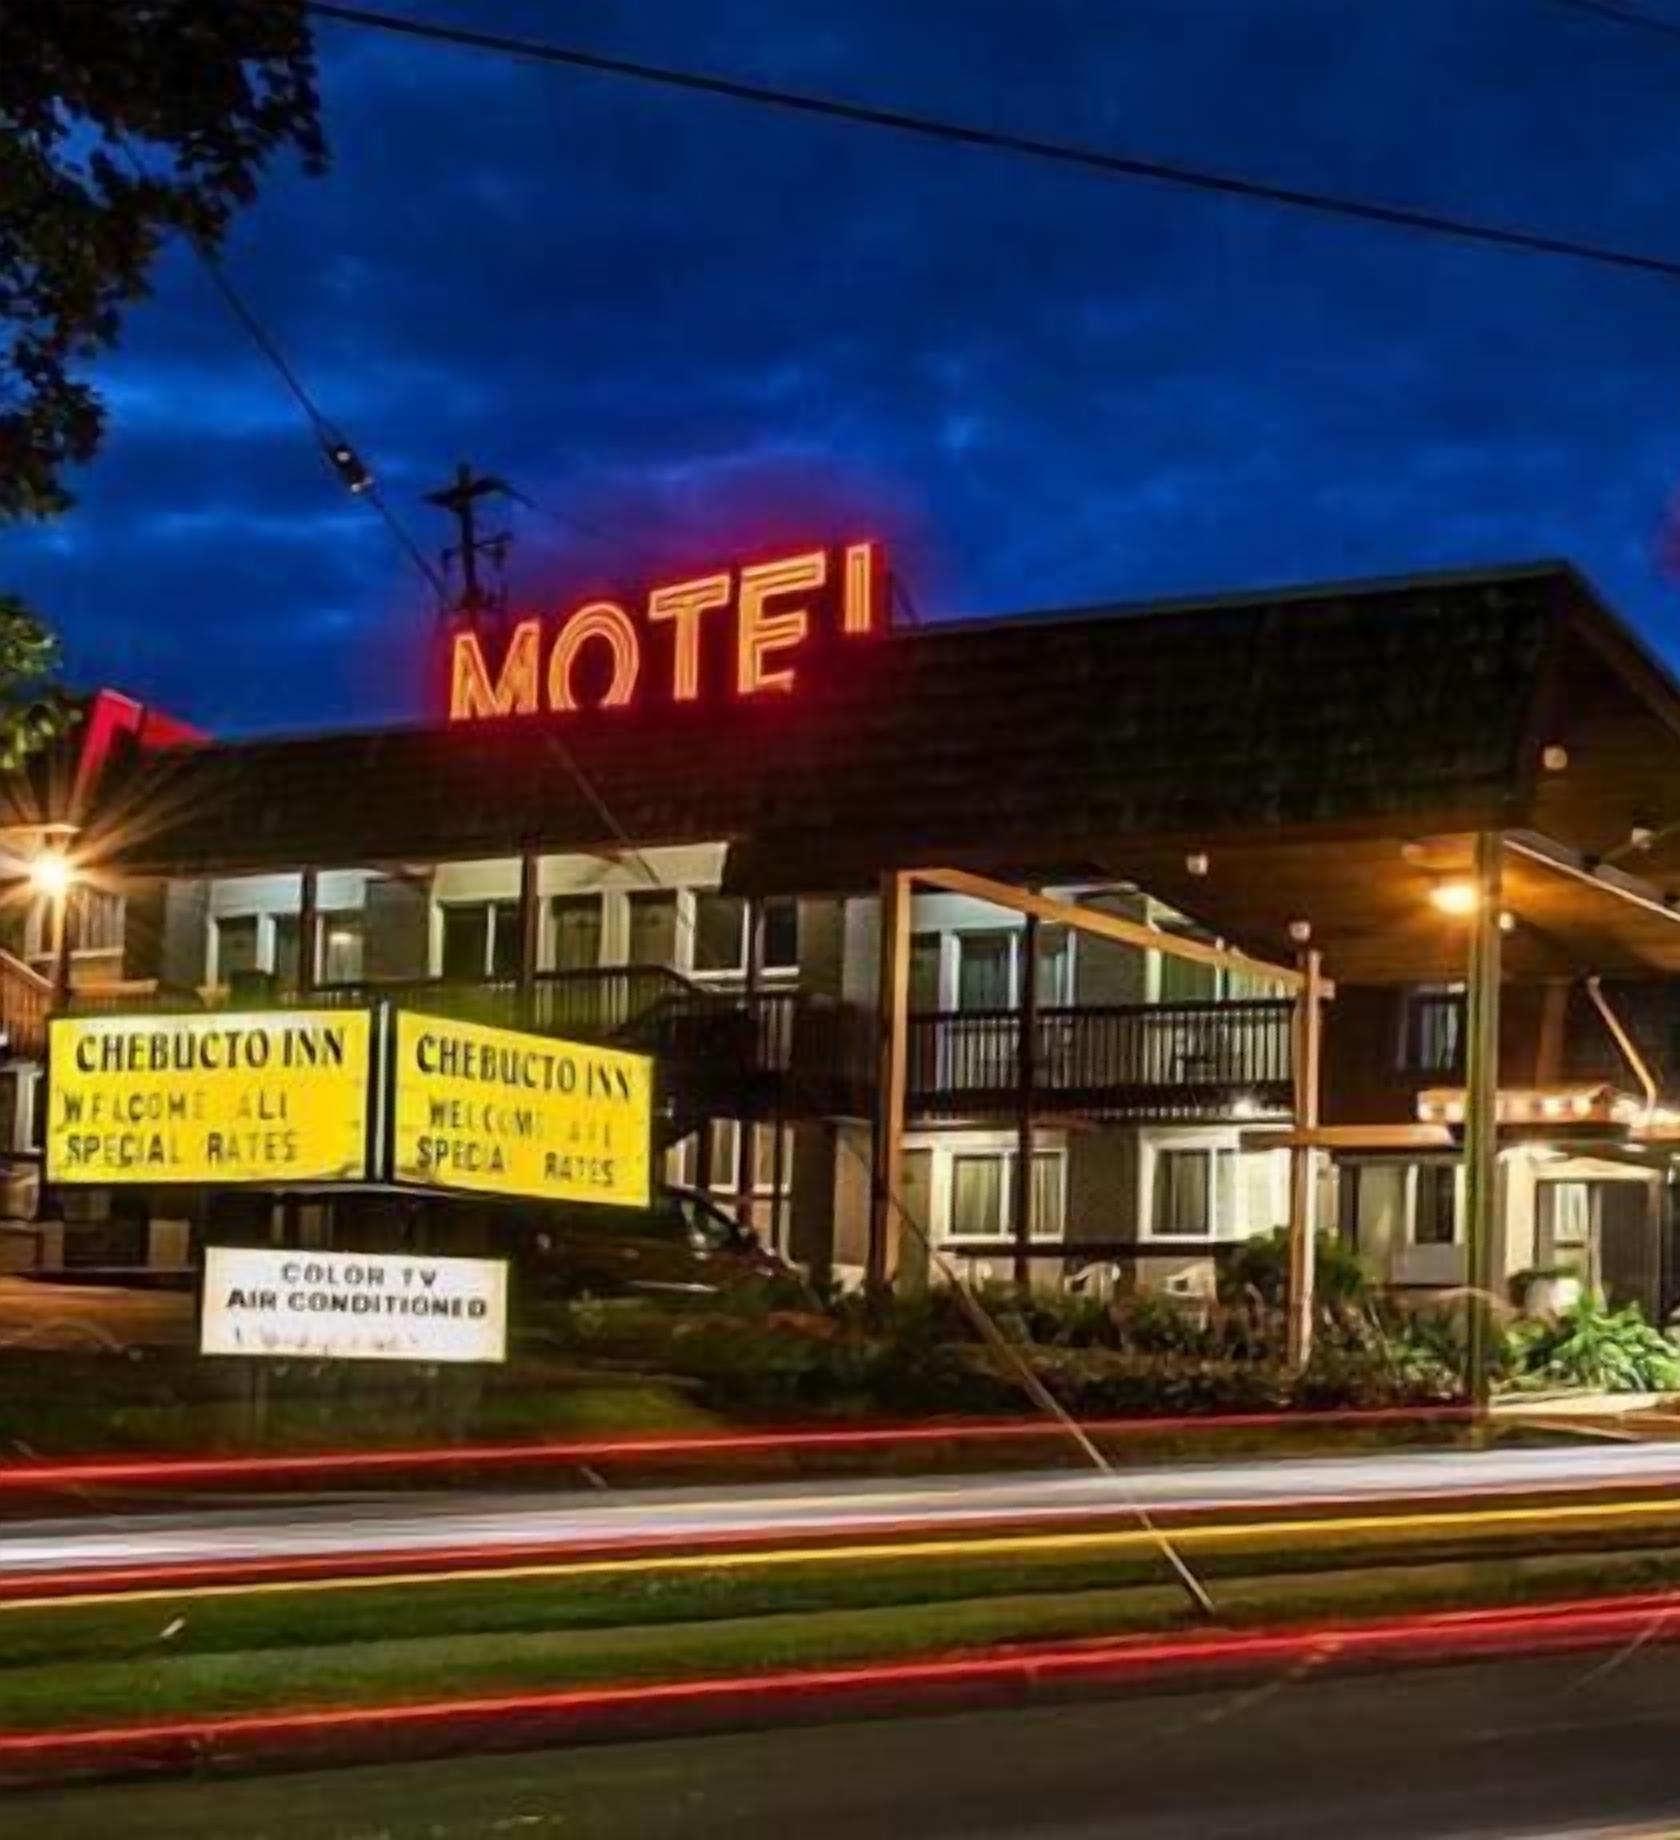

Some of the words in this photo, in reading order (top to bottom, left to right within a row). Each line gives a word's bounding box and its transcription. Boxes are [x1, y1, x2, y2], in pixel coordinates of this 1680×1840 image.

[76, 1028, 270, 1072] CHEBUCTO
[283, 1027, 344, 1067] INN
[416, 1033, 576, 1092] CHEBUCTO
[587, 1060, 631, 1102] INN
[67, 1132, 181, 1167] SPECIAL
[207, 1131, 298, 1166] RATES
[417, 1136, 511, 1174] SPECA
[281, 1261, 384, 1286] COLOR
[402, 1267, 437, 1288] TV
[226, 1288, 277, 1311] AIR
[287, 1290, 488, 1318] CONDITIONED
